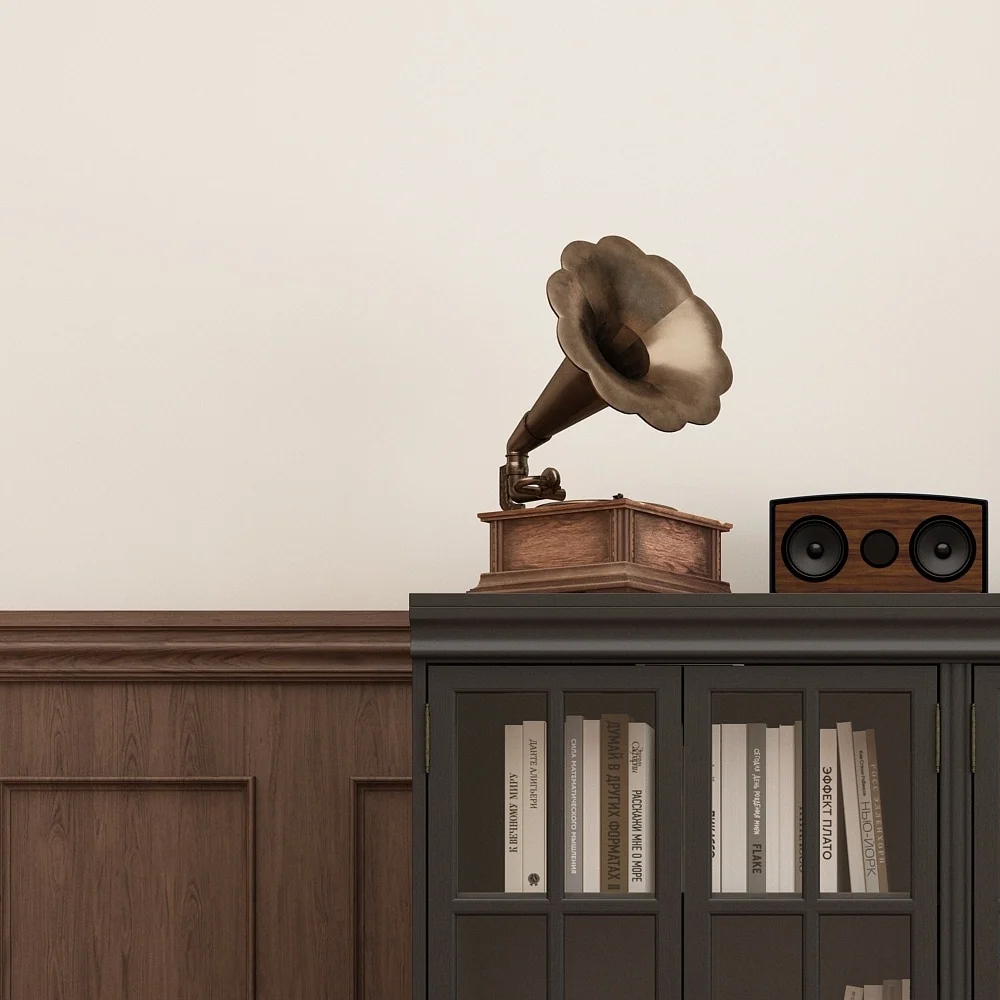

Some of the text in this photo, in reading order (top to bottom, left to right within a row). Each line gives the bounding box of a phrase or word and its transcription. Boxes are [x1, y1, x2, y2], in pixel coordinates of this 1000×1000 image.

[606, 721, 624, 760] ДУМАЙ
[508, 772, 518, 800] МИРУ
[528, 739, 538, 809] ДАНТЕ АЛИГЬЕРИ
[606, 775, 621, 818] ДРУГИХ
[631, 789, 643, 831] РАССКАЖИ
[822, 766, 832, 860] ЭФФЕКТ ПЛАТО
[508, 803, 518, 845] ВЕЧНОМУ
[631, 834, 643, 851] МНЕ
[860, 801, 877, 877] НЬЮ-ЙОРК
[607, 821, 621, 880] ФОРМАТАХ
[752, 843, 762, 874] FLAKE
[631, 861, 643, 883] МОРЕ
